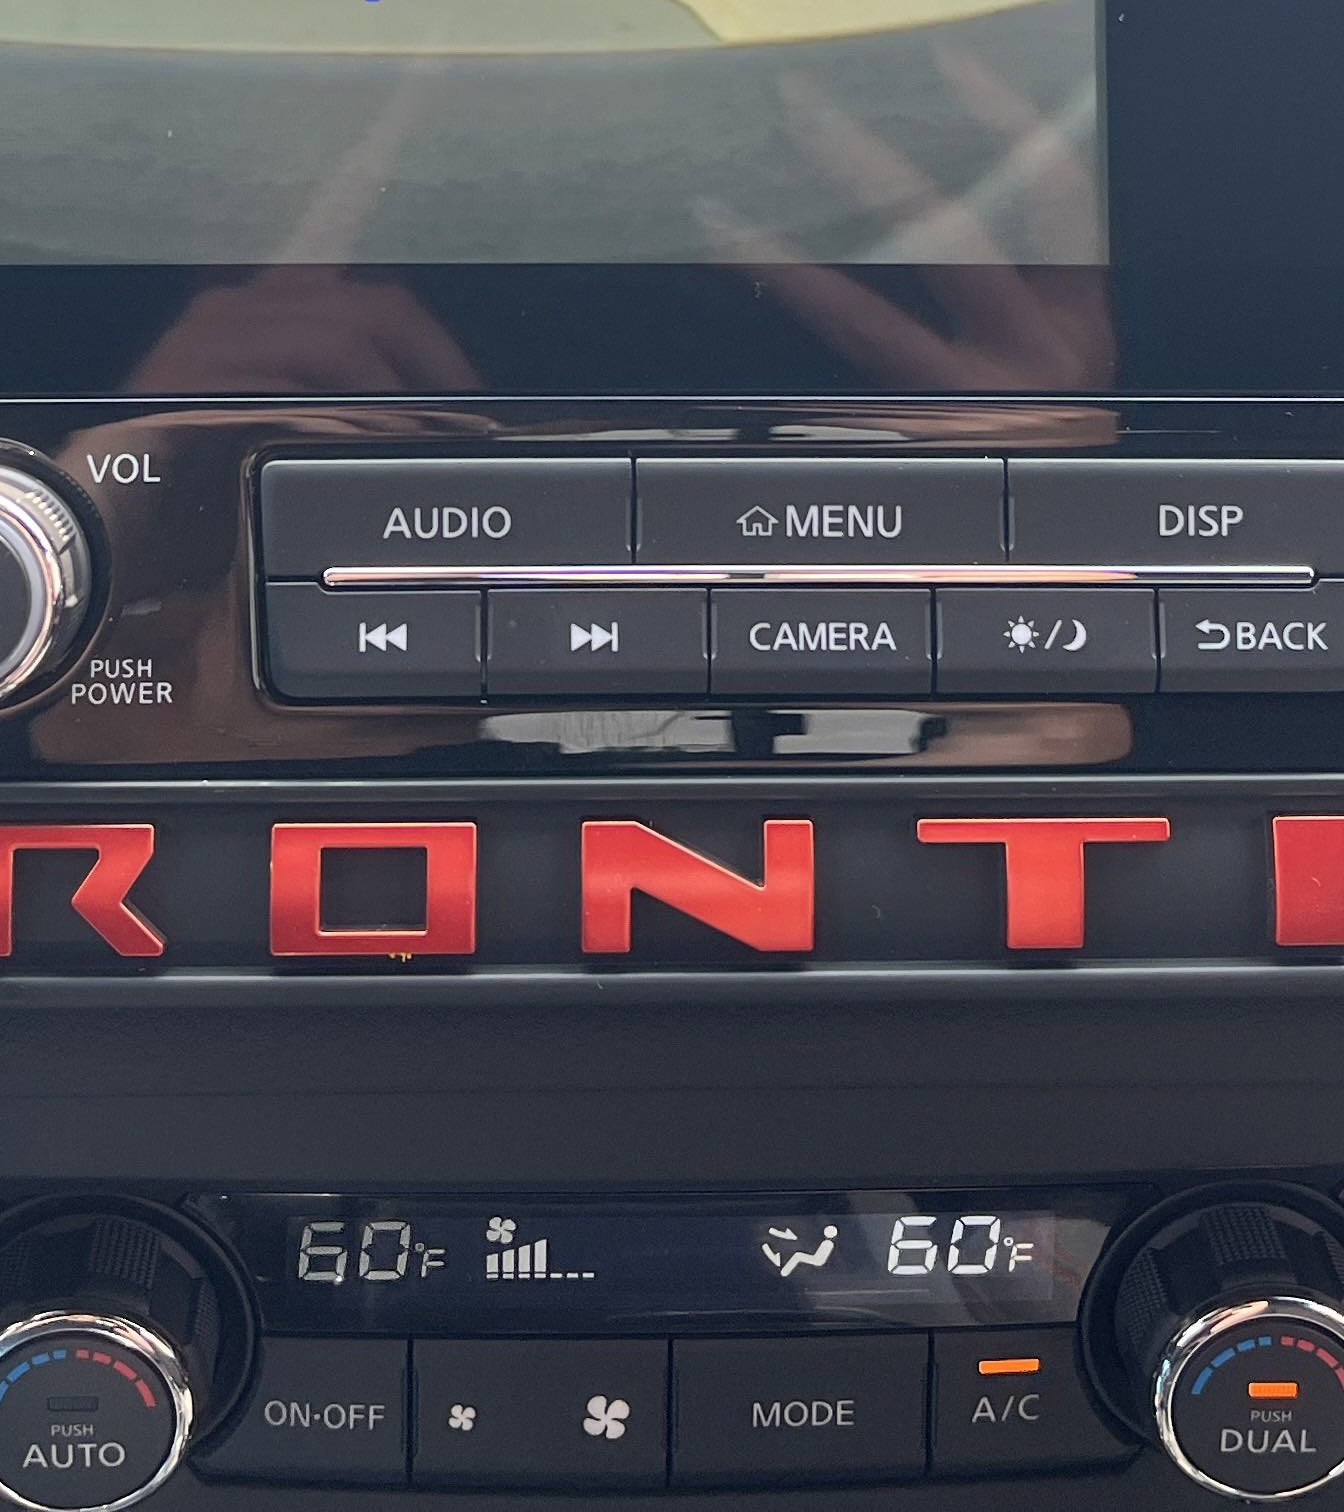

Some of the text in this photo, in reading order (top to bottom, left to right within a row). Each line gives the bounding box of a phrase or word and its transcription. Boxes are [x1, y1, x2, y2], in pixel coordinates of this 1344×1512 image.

[86, 453, 161, 485] VOL
[383, 505, 512, 540] AUDIO
[785, 505, 903, 539] MENU
[1159, 504, 1245, 538] DISP
[748, 621, 897, 652] CAMERA
[1235, 621, 1329, 651] BACK
[89, 658, 153, 680] PUSH
[71, 682, 173, 706] POWER
[751, 1399, 855, 1428] MODE
[971, 1394, 1040, 1424] A/C
[1250, 1410, 1293, 1423] PUSH
[51, 1423, 94, 1437] PUSH
[1220, 1428, 1317, 1454] DUAL
[22, 1441, 126, 1469] AUTO
